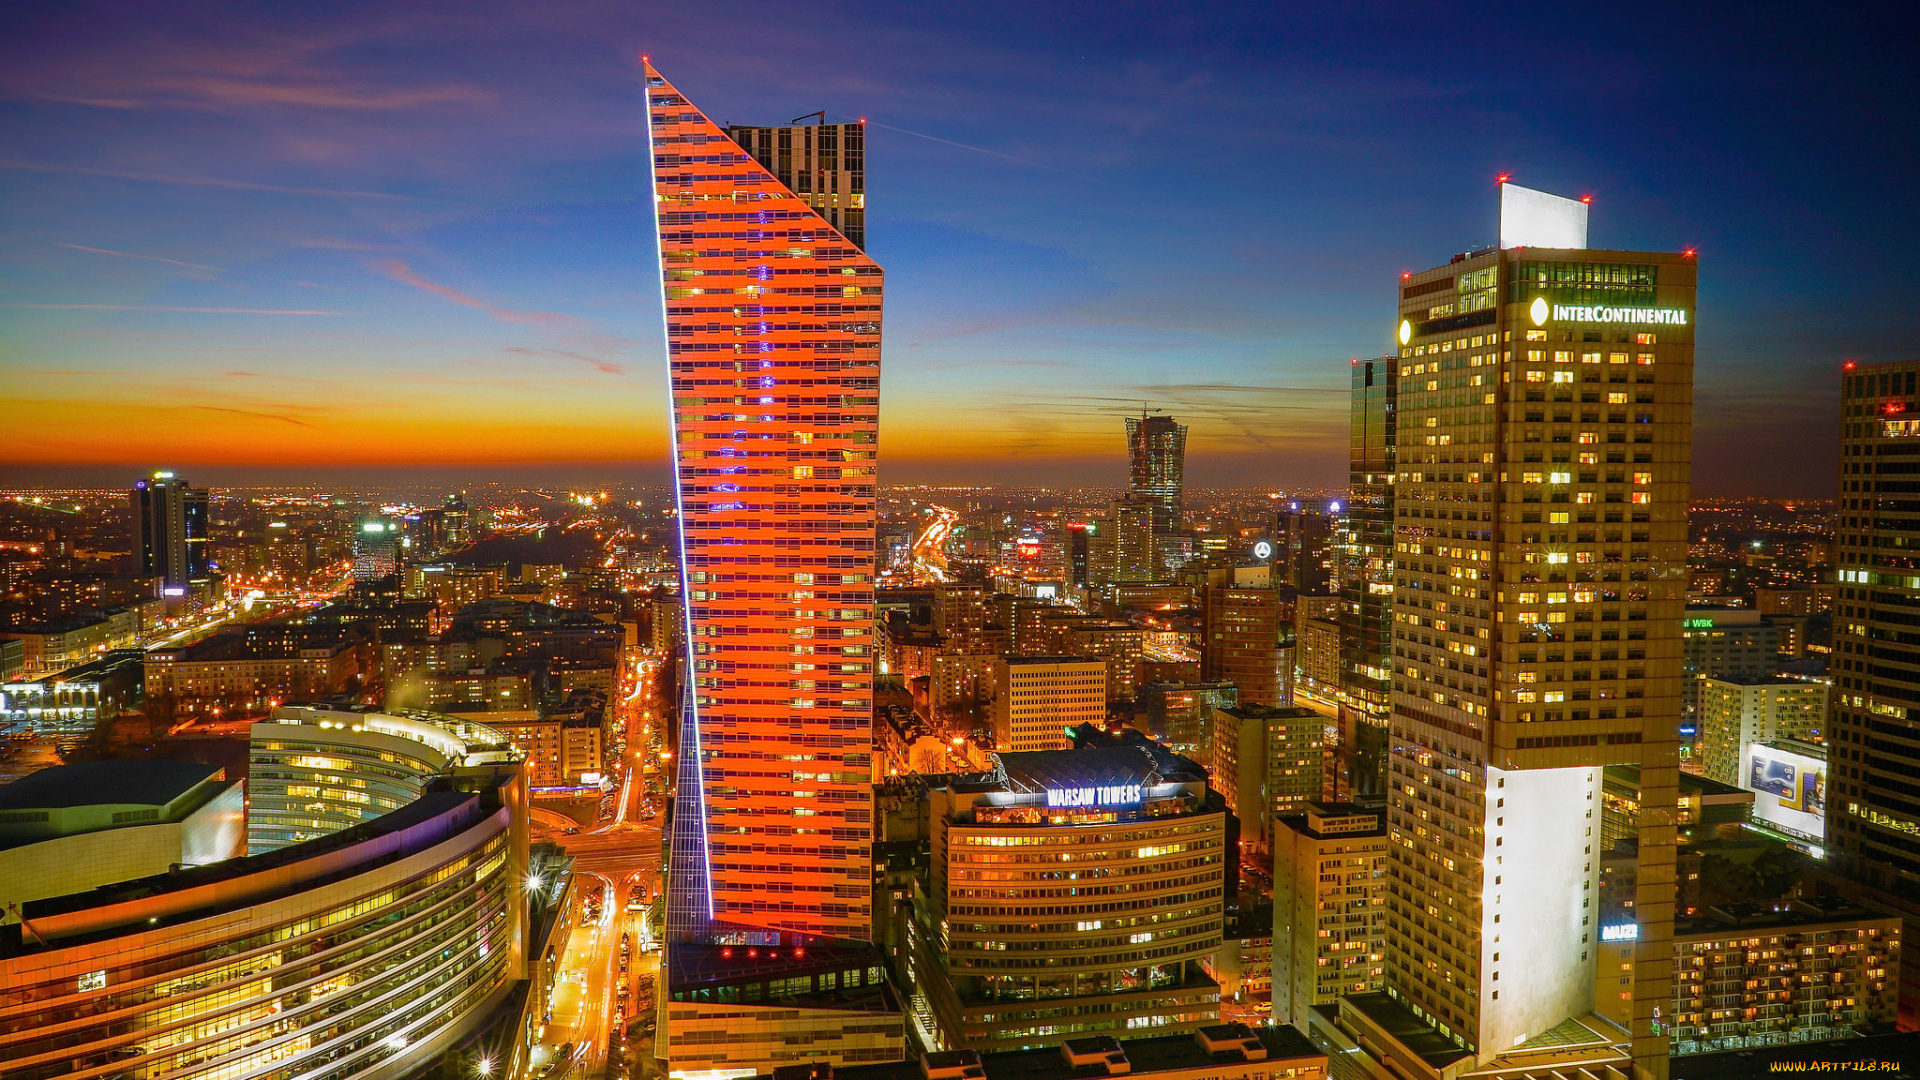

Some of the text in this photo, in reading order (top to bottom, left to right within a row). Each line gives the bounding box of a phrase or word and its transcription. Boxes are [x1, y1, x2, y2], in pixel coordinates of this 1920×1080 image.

[1692, 619, 1713, 627] WBK
[1047, 784, 1141, 807] WARSAW TOWERS
